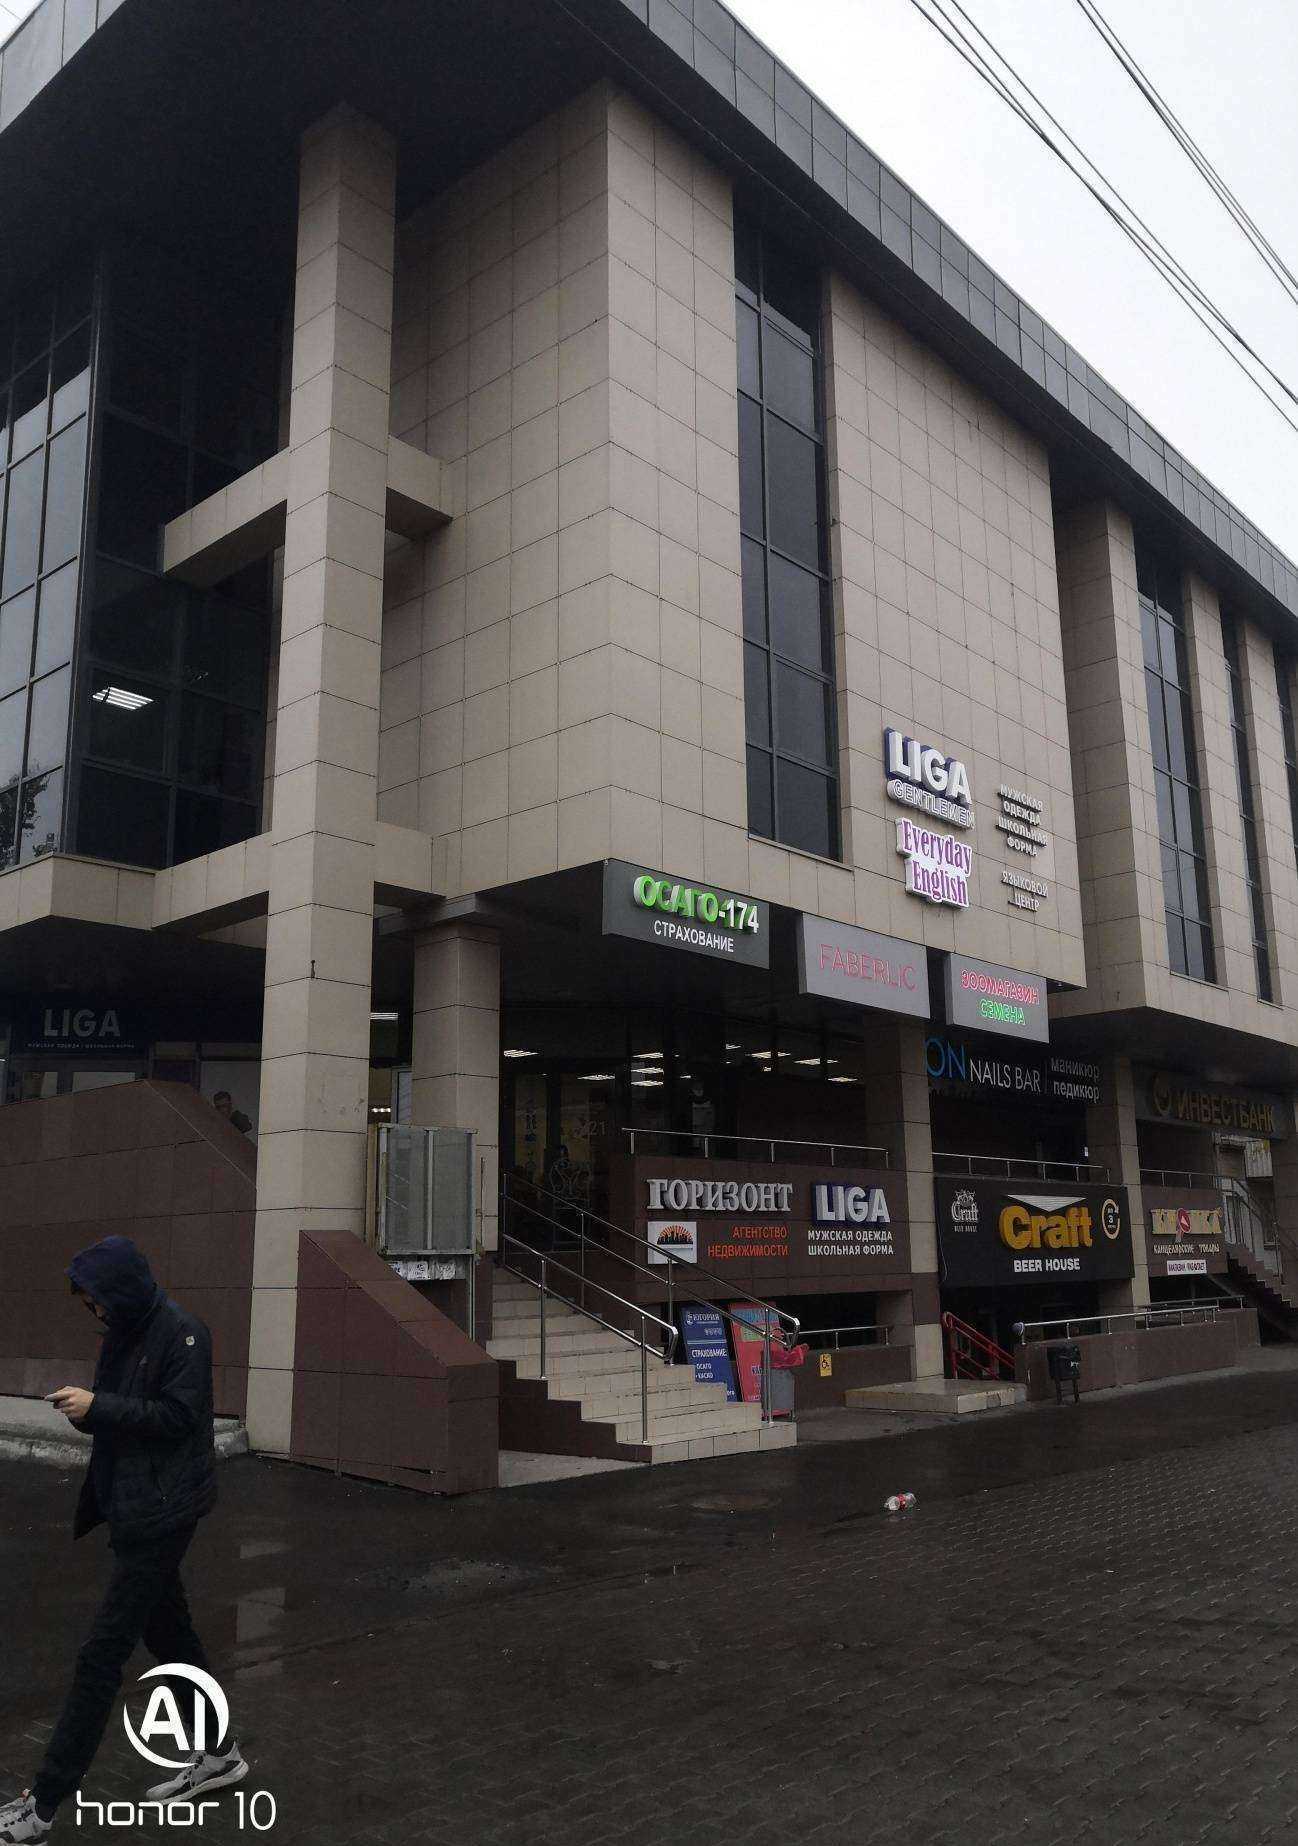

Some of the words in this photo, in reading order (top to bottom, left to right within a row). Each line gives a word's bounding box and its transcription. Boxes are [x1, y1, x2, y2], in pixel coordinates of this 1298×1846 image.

[885, 727, 973, 806] LIGA
[887, 779, 975, 830] GENTLEMEN
[1000, 784, 1043, 811] МУЖСКАЯ
[1003, 801, 1041, 825] ОДЕЖДА
[998, 816, 1048, 845] ШКОЛЬНАЯ
[902, 819, 972, 876] Everyday
[1007, 837, 1039, 856] ФОРМА
[912, 860, 968, 906] English
[633, 875, 760, 934] ОСАГО-174
[1015, 892, 1040, 911] ЦЕНТР
[653, 919, 735, 953] СТРАХОВАНИЕ
[818, 943, 918, 992] FABERLIC
[961, 969, 1040, 1005] ЗООМАГАЗИН
[44, 1008, 121, 1037] LIGA
[980, 999, 1026, 1025] СЕМЕНА
[970, 1059, 1011, 1089] NAILS
[1015, 1063, 1041, 1093] BAR
[1051, 1057, 1100, 1081] маникюр
[1053, 1080, 1100, 1104] педикюр
[1176, 1090, 1274, 1132] ИНВЕСТБАНК
[646, 1178, 793, 1212] ГОРИЗОНТ
[814, 1183, 891, 1223] LIGA
[732, 1226, 788, 1239] АГЕНТСТВО
[807, 1230, 853, 1241] МУЖСКАЯ
[856, 1230, 893, 1242] ОДЕЖДА
[999, 1205, 1092, 1250] Craft
[707, 1244, 788, 1258] НЕДВИЖИМОСТИ
[808, 1245, 861, 1256] ШКОЛЬНАЯ
[863, 1244, 894, 1255] ФОРМА
[1013, 1259, 1042, 1273] BEER
[1045, 1257, 1081, 1271] HOUSE
